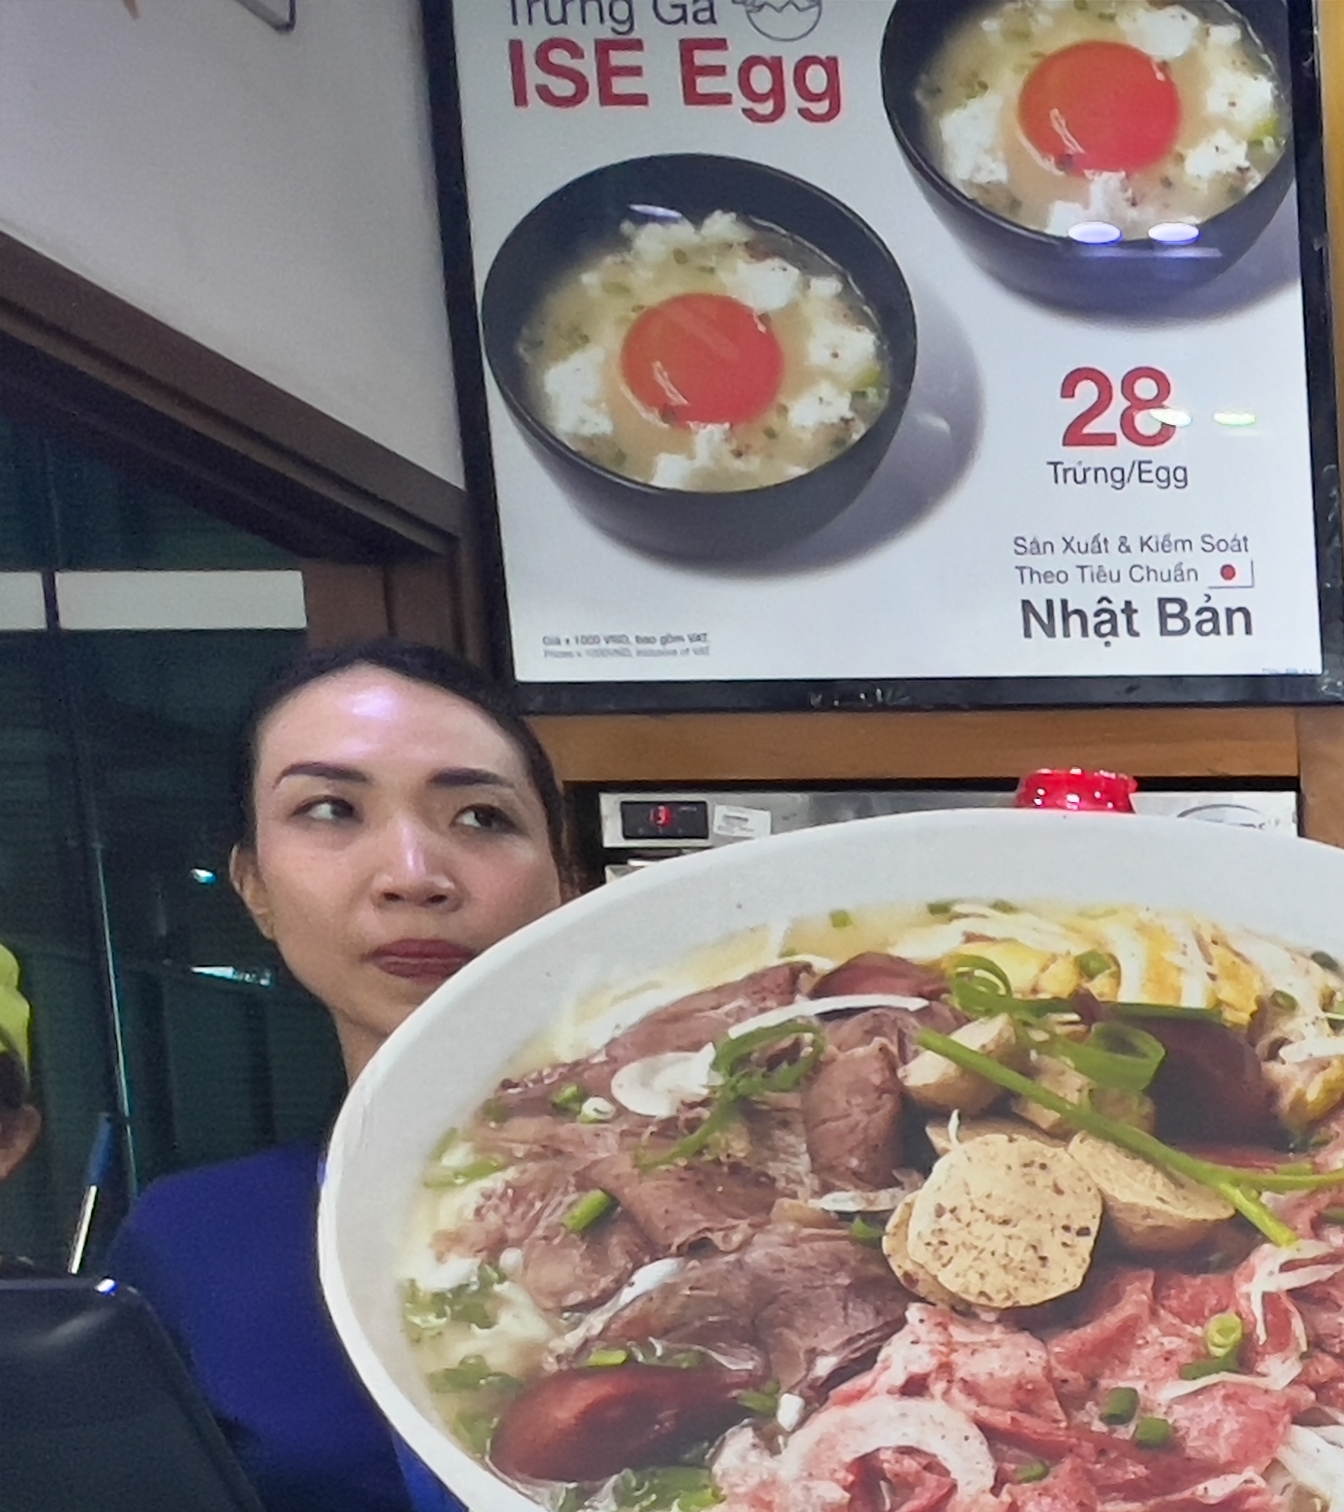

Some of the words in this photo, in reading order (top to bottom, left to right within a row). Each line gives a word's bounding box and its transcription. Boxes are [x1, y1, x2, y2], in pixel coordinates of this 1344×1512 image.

[508, 37, 649, 108] ISE
[679, 38, 841, 123] Egg
[1060, 366, 1177, 447] 28
[1047, 460, 1188, 489] Trứng/Egg
[1061, 532, 1109, 554] Xuất
[1117, 536, 1132, 553] &
[1200, 534, 1249, 553] Soát
[1015, 565, 1068, 584] Theo
[1076, 564, 1120, 583] Tiêu
[1021, 596, 1140, 647] Nhật
[1157, 594, 1253, 637] Bản
